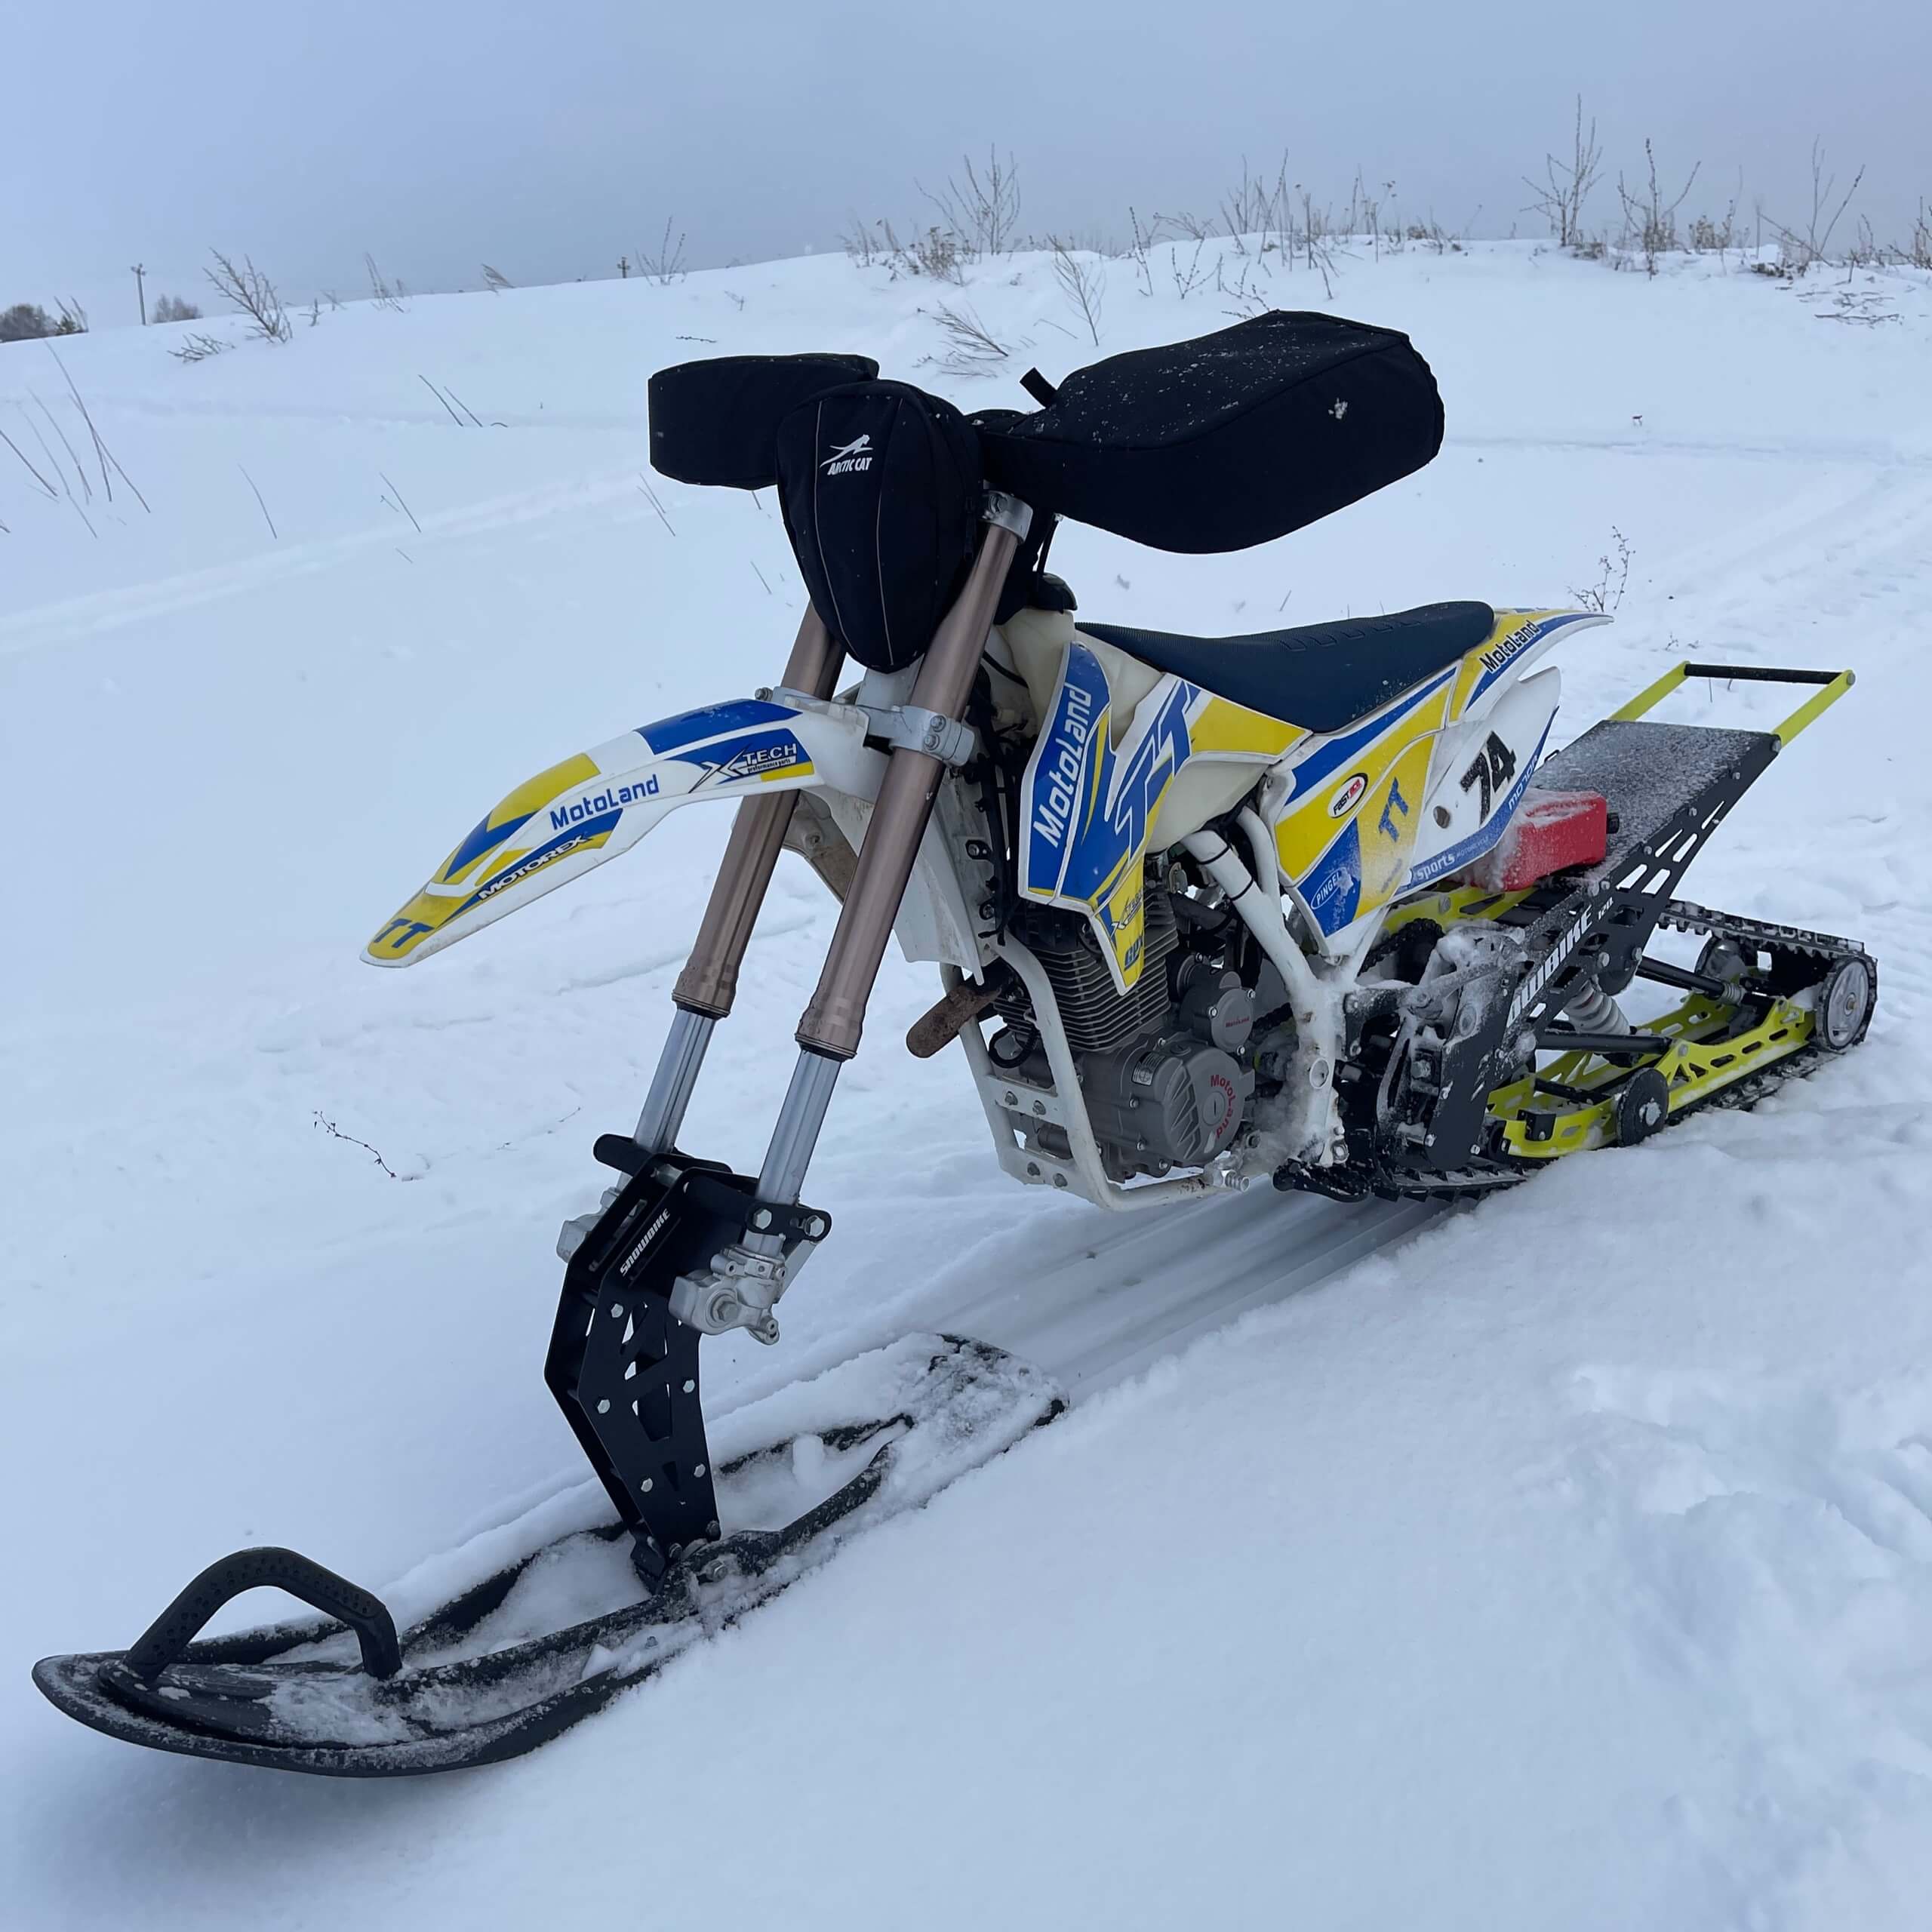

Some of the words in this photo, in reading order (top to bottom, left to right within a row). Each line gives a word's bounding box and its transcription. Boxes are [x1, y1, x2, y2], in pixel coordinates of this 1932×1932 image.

[854, 457, 872, 472] CAT
[1479, 619, 1541, 673] MotoLand
[1032, 681, 1093, 849] MotoLand
[1460, 730, 1517, 827] 74
[549, 774, 660, 830] MotoLand
[1378, 777, 1408, 843] TT
[477, 834, 592, 901] MOTOREX
[1417, 853, 1456, 880] sports
[373, 918, 435, 949] TT
[1210, 1074, 1236, 1139] MotoLand
[620, 1208, 670, 1277] SNOWBIKE
